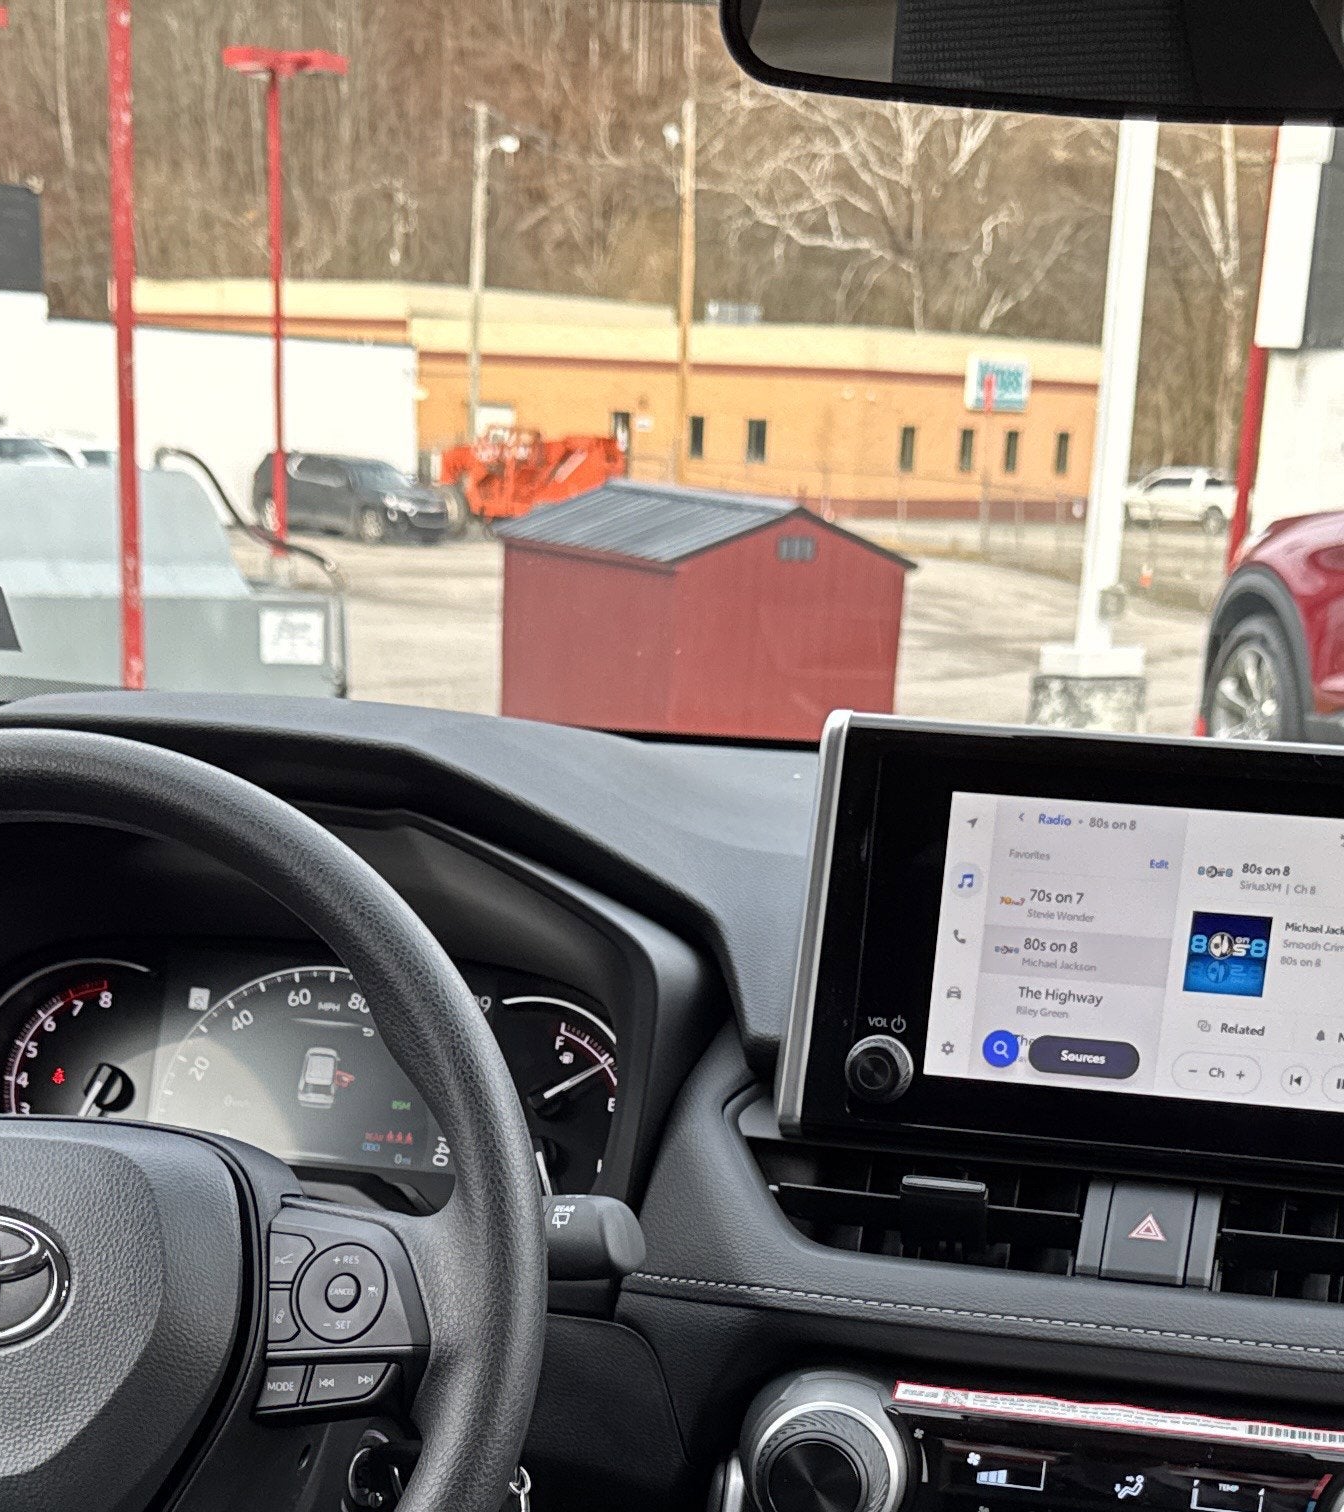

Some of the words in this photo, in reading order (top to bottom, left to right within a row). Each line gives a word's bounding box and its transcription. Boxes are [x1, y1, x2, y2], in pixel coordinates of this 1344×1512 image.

[1038, 813, 1072, 827] Radio
[1089, 816, 1109, 829] 80s
[1111, 819, 1127, 831] on
[1128, 820, 1137, 831] 8
[1008, 848, 1051, 861] Favorites
[1149, 859, 1169, 870] Edit
[1241, 862, 1263, 875] 80s
[1264, 865, 1281, 876] on
[1282, 865, 1291, 877] 8
[1239, 880, 1282, 893] SiriusXM
[1293, 884, 1308, 895] Ch
[1029, 888, 1052, 903] 70s
[1055, 892, 1073, 904] on
[1076, 891, 1085, 905] 7
[1026, 908, 1055, 922] Stevie
[1056, 910, 1095, 923] Wonder
[1284, 922, 1323, 935] Michael
[1023, 937, 1047, 952] 80s
[1049, 942, 1067, 953] on
[1069, 941, 1078, 954] 8
[1282, 938, 1321, 951] Smooth
[1021, 957, 1058, 970] Michael
[1059, 959, 1097, 972] Jackson
[1280, 955, 1296, 967] 80s
[1299, 958, 1313, 968] on
[1314, 958, 1322, 968] 8
[98, 991, 113, 1009] 8
[287, 988, 311, 1007] 60
[1018, 985, 1043, 1001] The
[1044, 988, 1104, 1007] Highway
[71, 1000, 84, 1017] 7
[317, 1001, 341, 1012] MPH
[1016, 1005, 1039, 1018] Riley
[1040, 1008, 1069, 1019] Green
[42, 1017, 57, 1032] 6
[231, 1010, 254, 1031] 40
[868, 1016, 888, 1028] VOL
[1220, 1022, 1265, 1036] Related
[25, 1040, 38, 1058] 5
[555, 1036, 565, 1050] F
[1060, 1050, 1106, 1065] Sources
[191, 1056, 210, 1081] 20
[1208, 1067, 1225, 1079] Ch
[16, 1072, 29, 1088] 4
[20, 1101, 31, 1114] 3
[554, 1204, 576, 1212] REAR
[342, 1255, 360, 1264] RES
[329, 1287, 355, 1296] CANCEL
[336, 1320, 351, 1330] SET
[267, 1380, 294, 1392] MODE
[1218, 1483, 1240, 1493] TEMP
